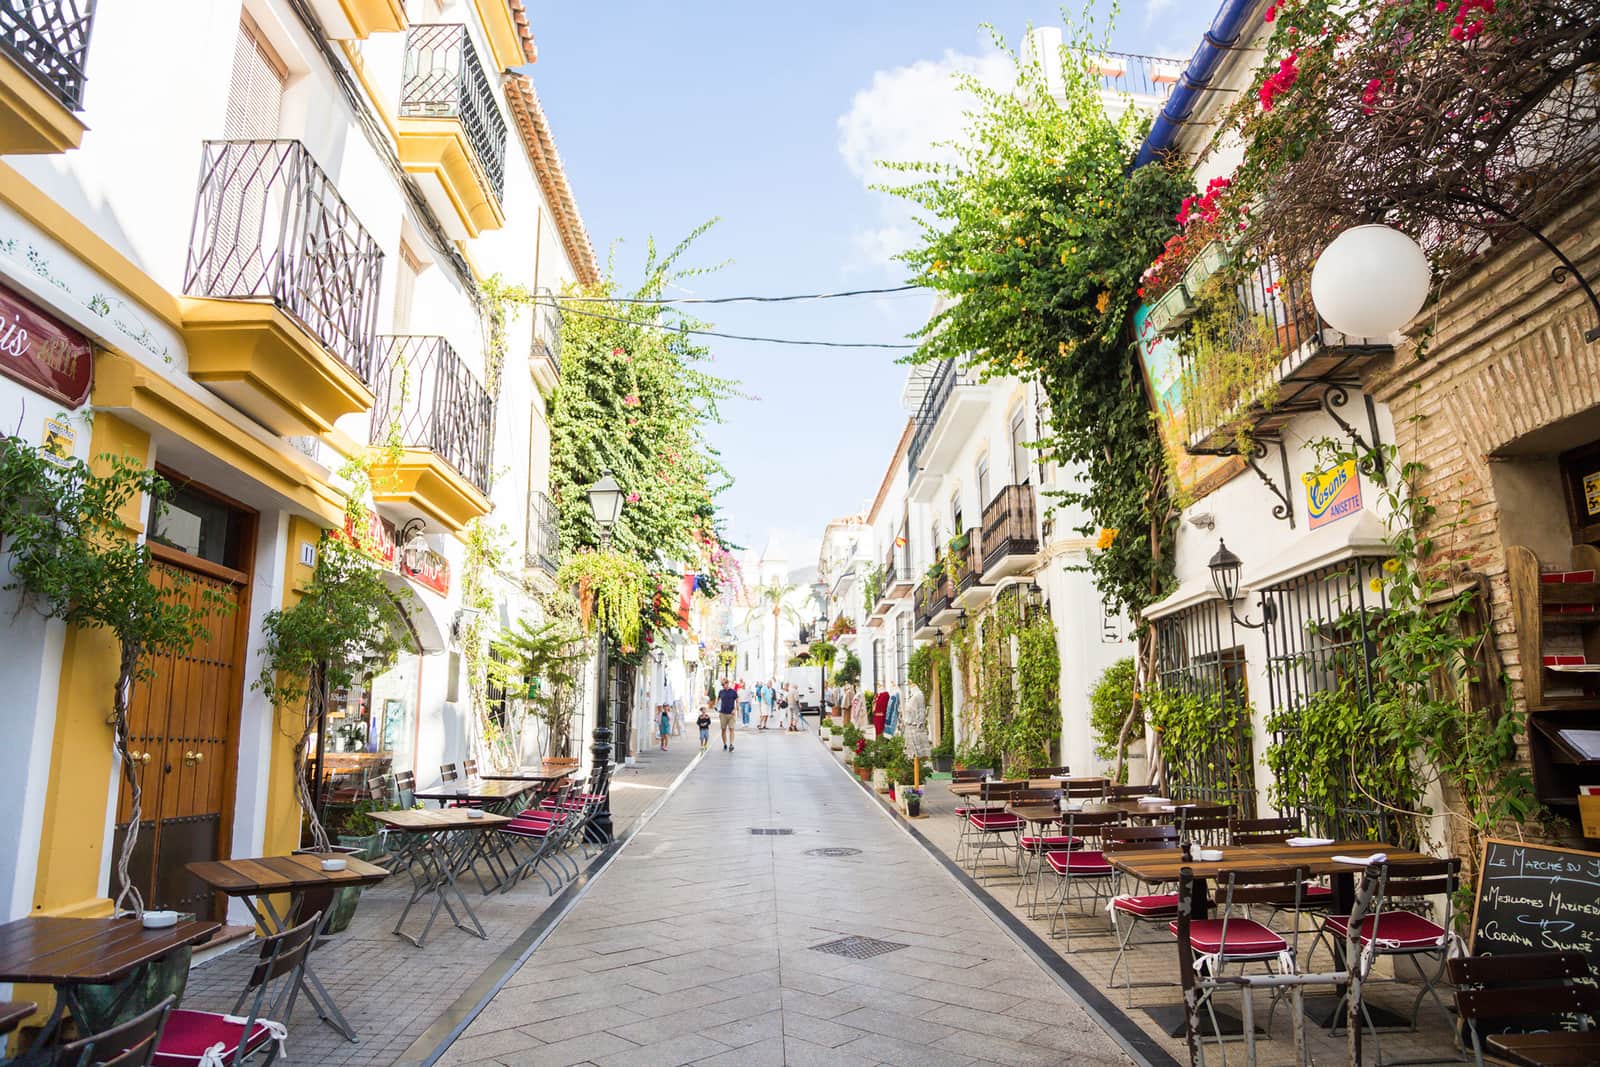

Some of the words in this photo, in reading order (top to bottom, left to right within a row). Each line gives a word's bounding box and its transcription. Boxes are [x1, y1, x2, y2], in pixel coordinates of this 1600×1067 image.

[1310, 468, 1347, 510] Casanis
[1330, 495, 1360, 516] ANISETTE
[1512, 848, 1563, 879] MARCHÉ
